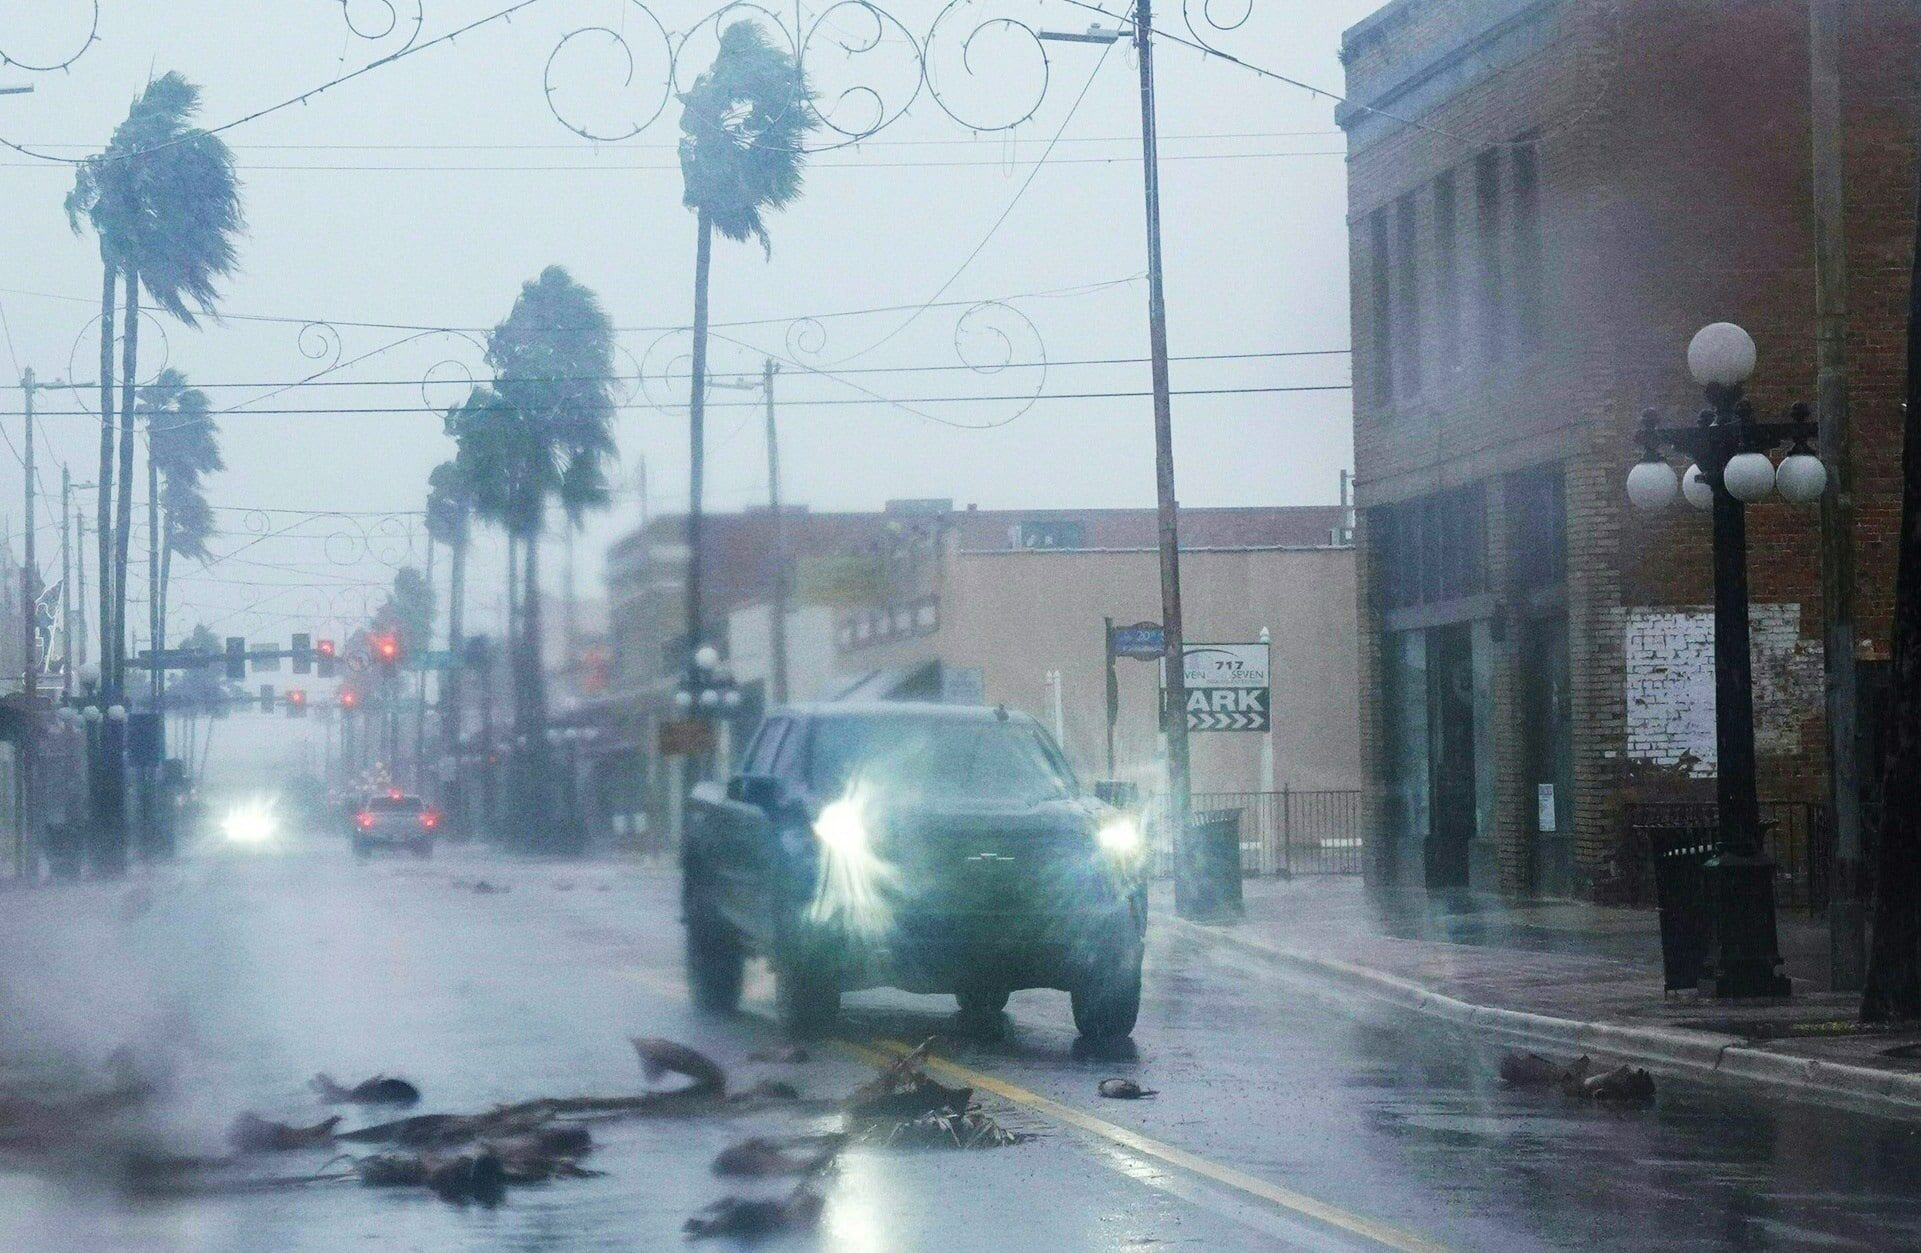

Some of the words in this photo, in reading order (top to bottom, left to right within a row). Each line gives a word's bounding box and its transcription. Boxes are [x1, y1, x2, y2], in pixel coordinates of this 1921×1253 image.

[1215, 661, 1244, 670] 717
[1231, 670, 1264, 679] SEVEN
[1164, 690, 1264, 712] ARK
